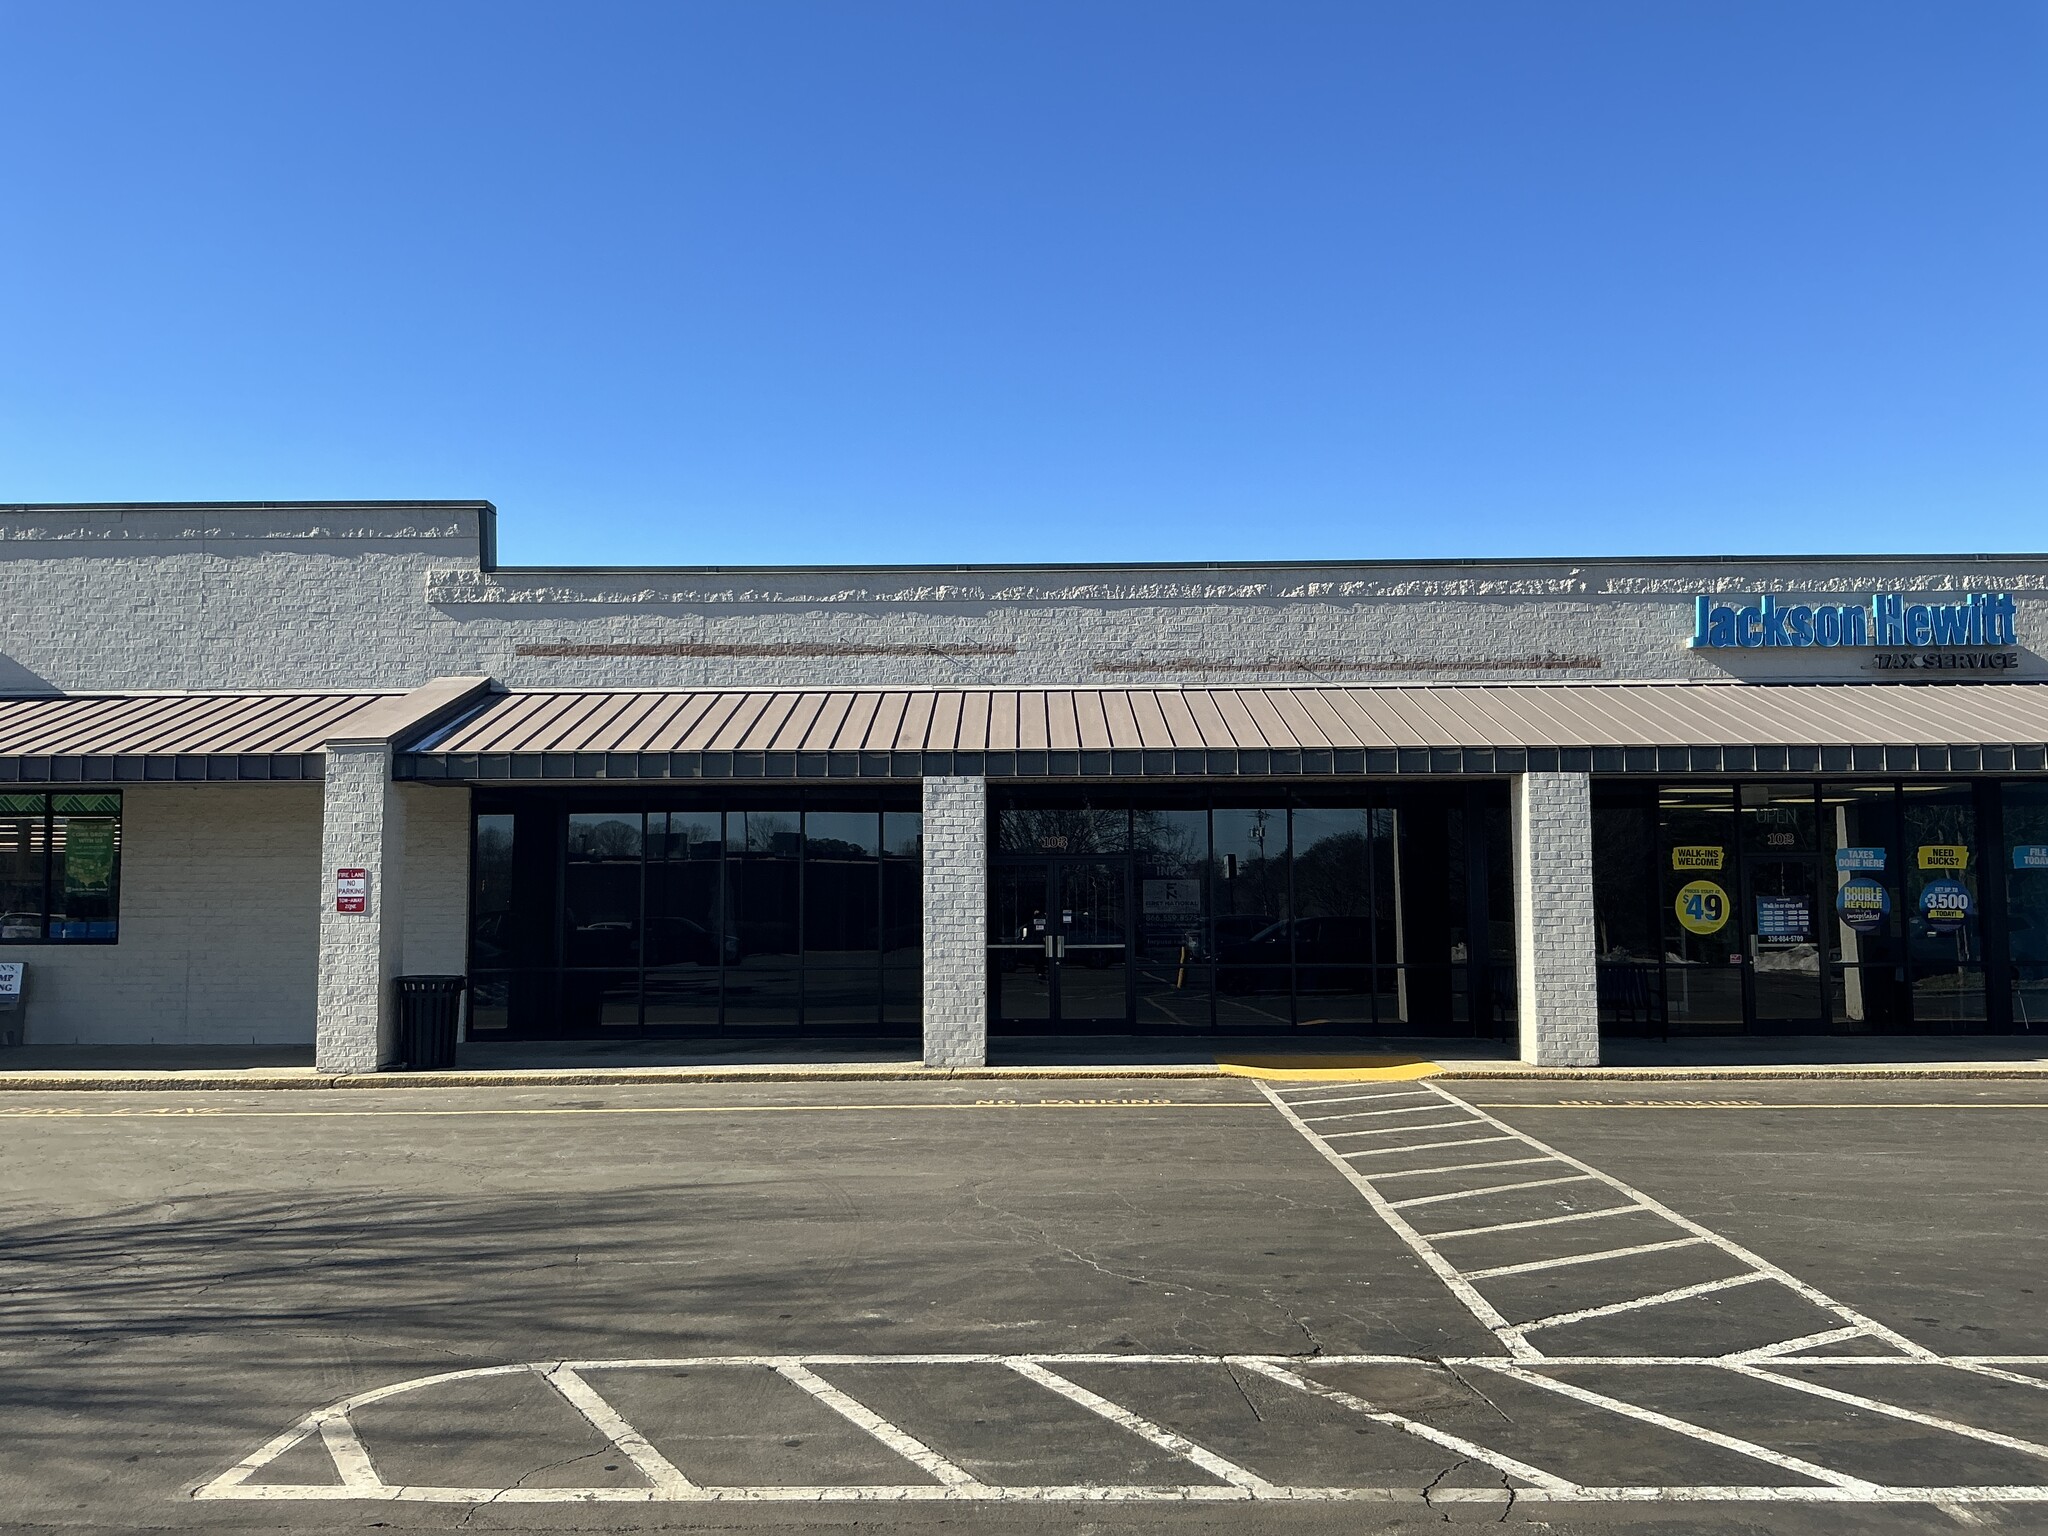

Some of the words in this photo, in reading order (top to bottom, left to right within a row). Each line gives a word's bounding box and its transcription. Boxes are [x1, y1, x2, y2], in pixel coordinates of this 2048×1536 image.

[1687, 594, 1869, 648] Jackson
[1872, 593, 2018, 647] Hewitt
[1878, 652, 1918, 669] TAX
[1923, 652, 2018, 669] SERVICE
[1756, 808, 1797, 824] OPEN
[1767, 832, 1794, 845] 102
[1677, 849, 1719, 858] WALK-INS
[1848, 850, 1874, 859] TAXES
[1932, 849, 1954, 857] NEED
[2029, 848, 2047, 856] FILE
[1677, 858, 1719, 866] WELCOME
[1839, 859, 1861, 867] DONE
[1863, 859, 1885, 868] HERE
[1927, 857, 1960, 866] BUCKS?
[1844, 886, 1882, 894] DOUBLE
[1844, 893, 1882, 901] DOUBLE
[1682, 894, 1723, 921] $49
[1844, 901, 1883, 909] REFUND!
